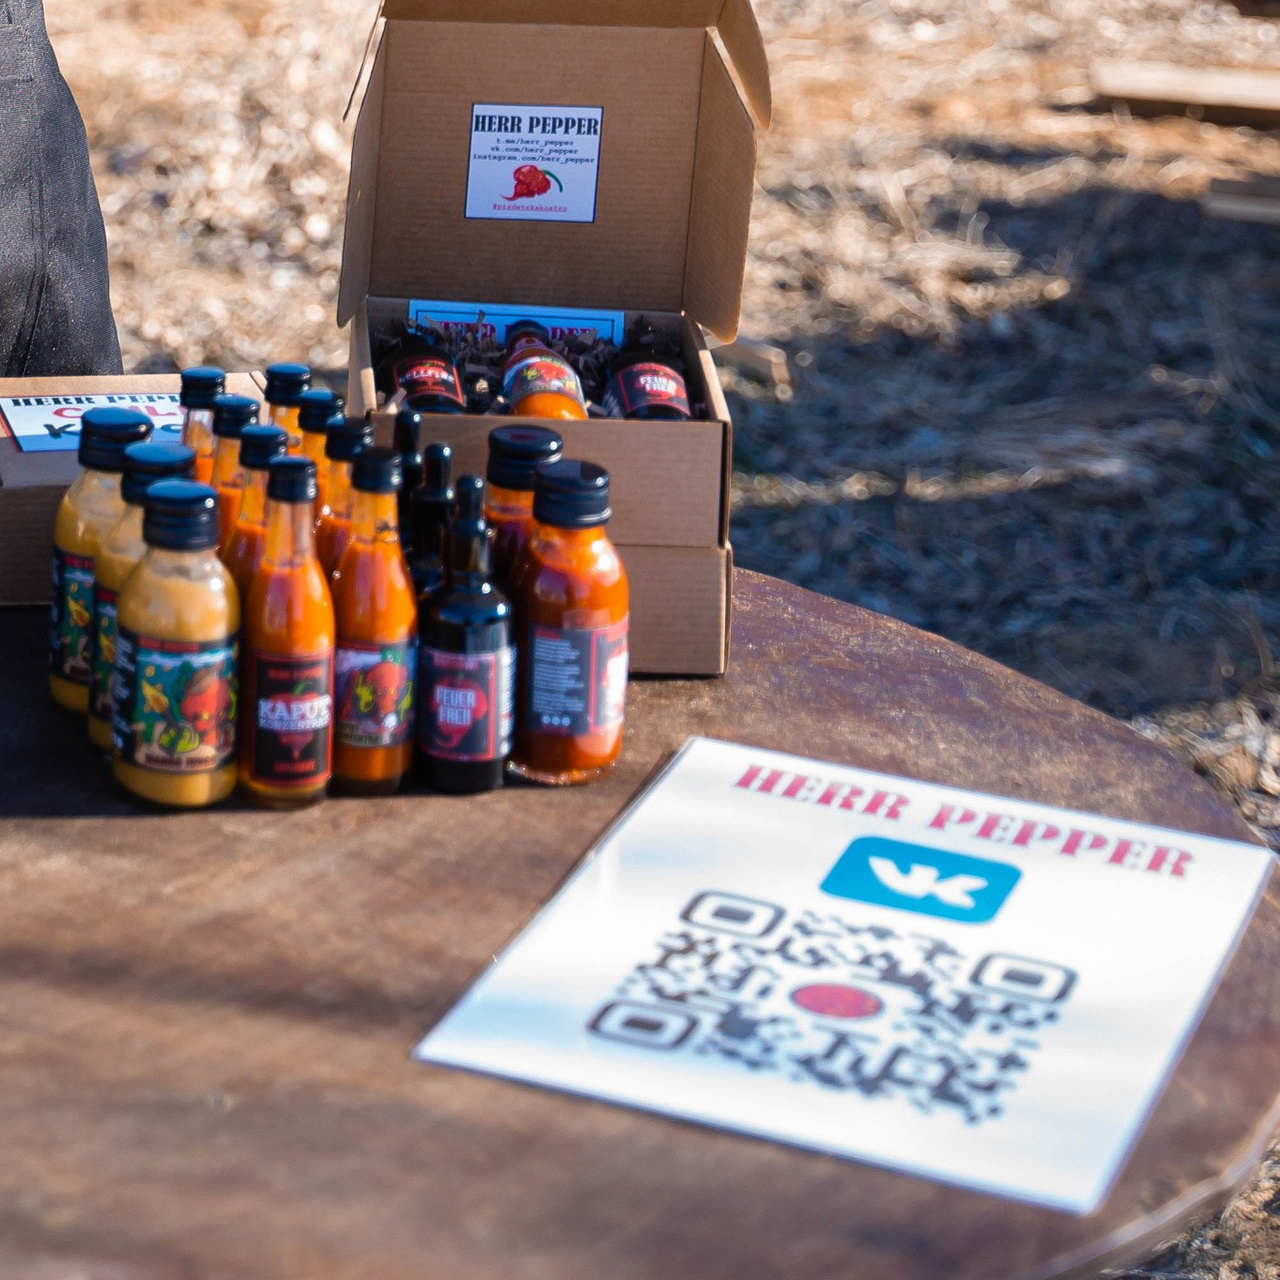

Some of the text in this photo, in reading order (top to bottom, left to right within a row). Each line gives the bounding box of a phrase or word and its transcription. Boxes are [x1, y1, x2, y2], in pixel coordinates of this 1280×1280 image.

[474, 114, 599, 136] HERR PEPPER
[473, 153, 595, 164] instagram.com/herr_pepper
[490, 146, 579, 156] vk.com/herr_pepper
[11, 397, 95, 407] HERR
[258, 694, 331, 721] KAPUT
[434, 684, 475, 709] FEUER
[732, 764, 1194, 879] HERR PEPPER
